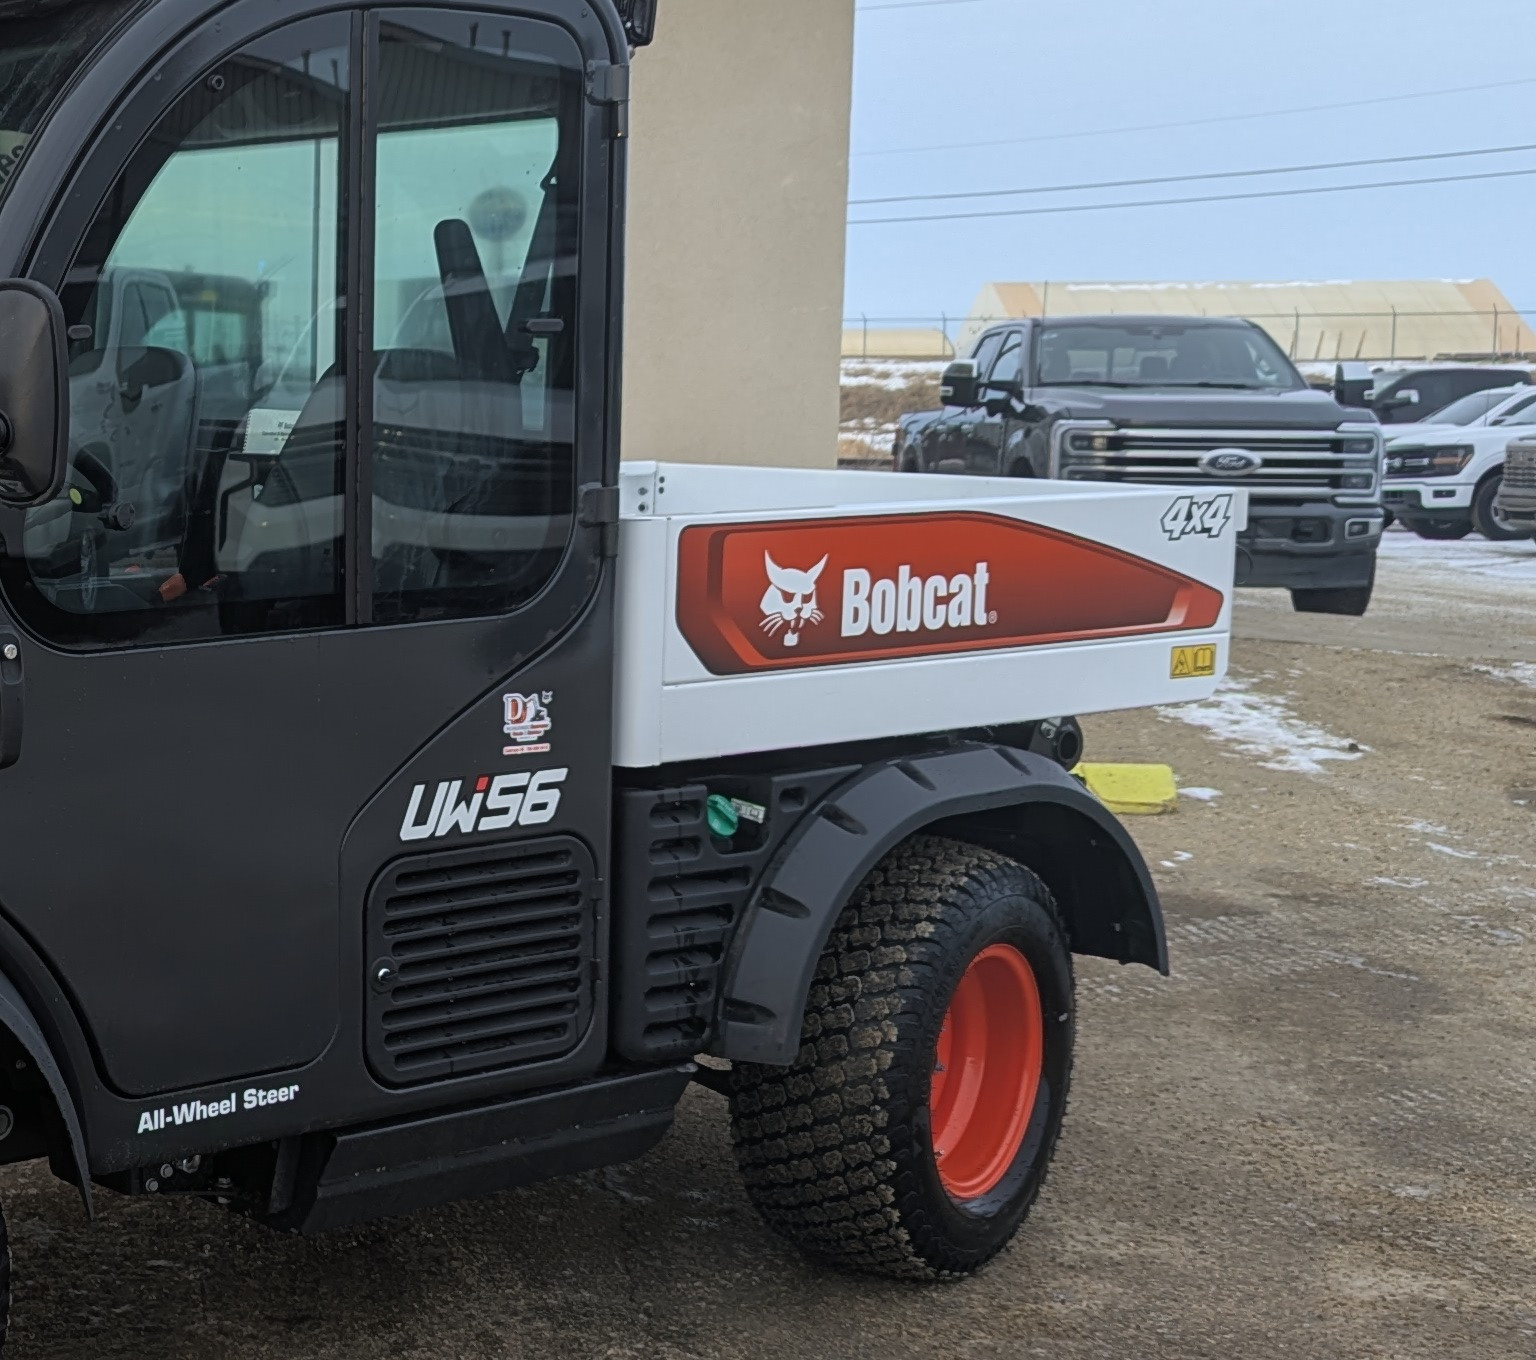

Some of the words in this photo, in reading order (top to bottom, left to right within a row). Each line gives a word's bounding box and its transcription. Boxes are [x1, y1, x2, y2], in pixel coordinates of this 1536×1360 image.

[1160, 494, 1233, 540] 4x4
[840, 561, 990, 637] Bobcat
[137, 1092, 237, 1134] All-Wheel
[243, 1084, 300, 1110] Steer
